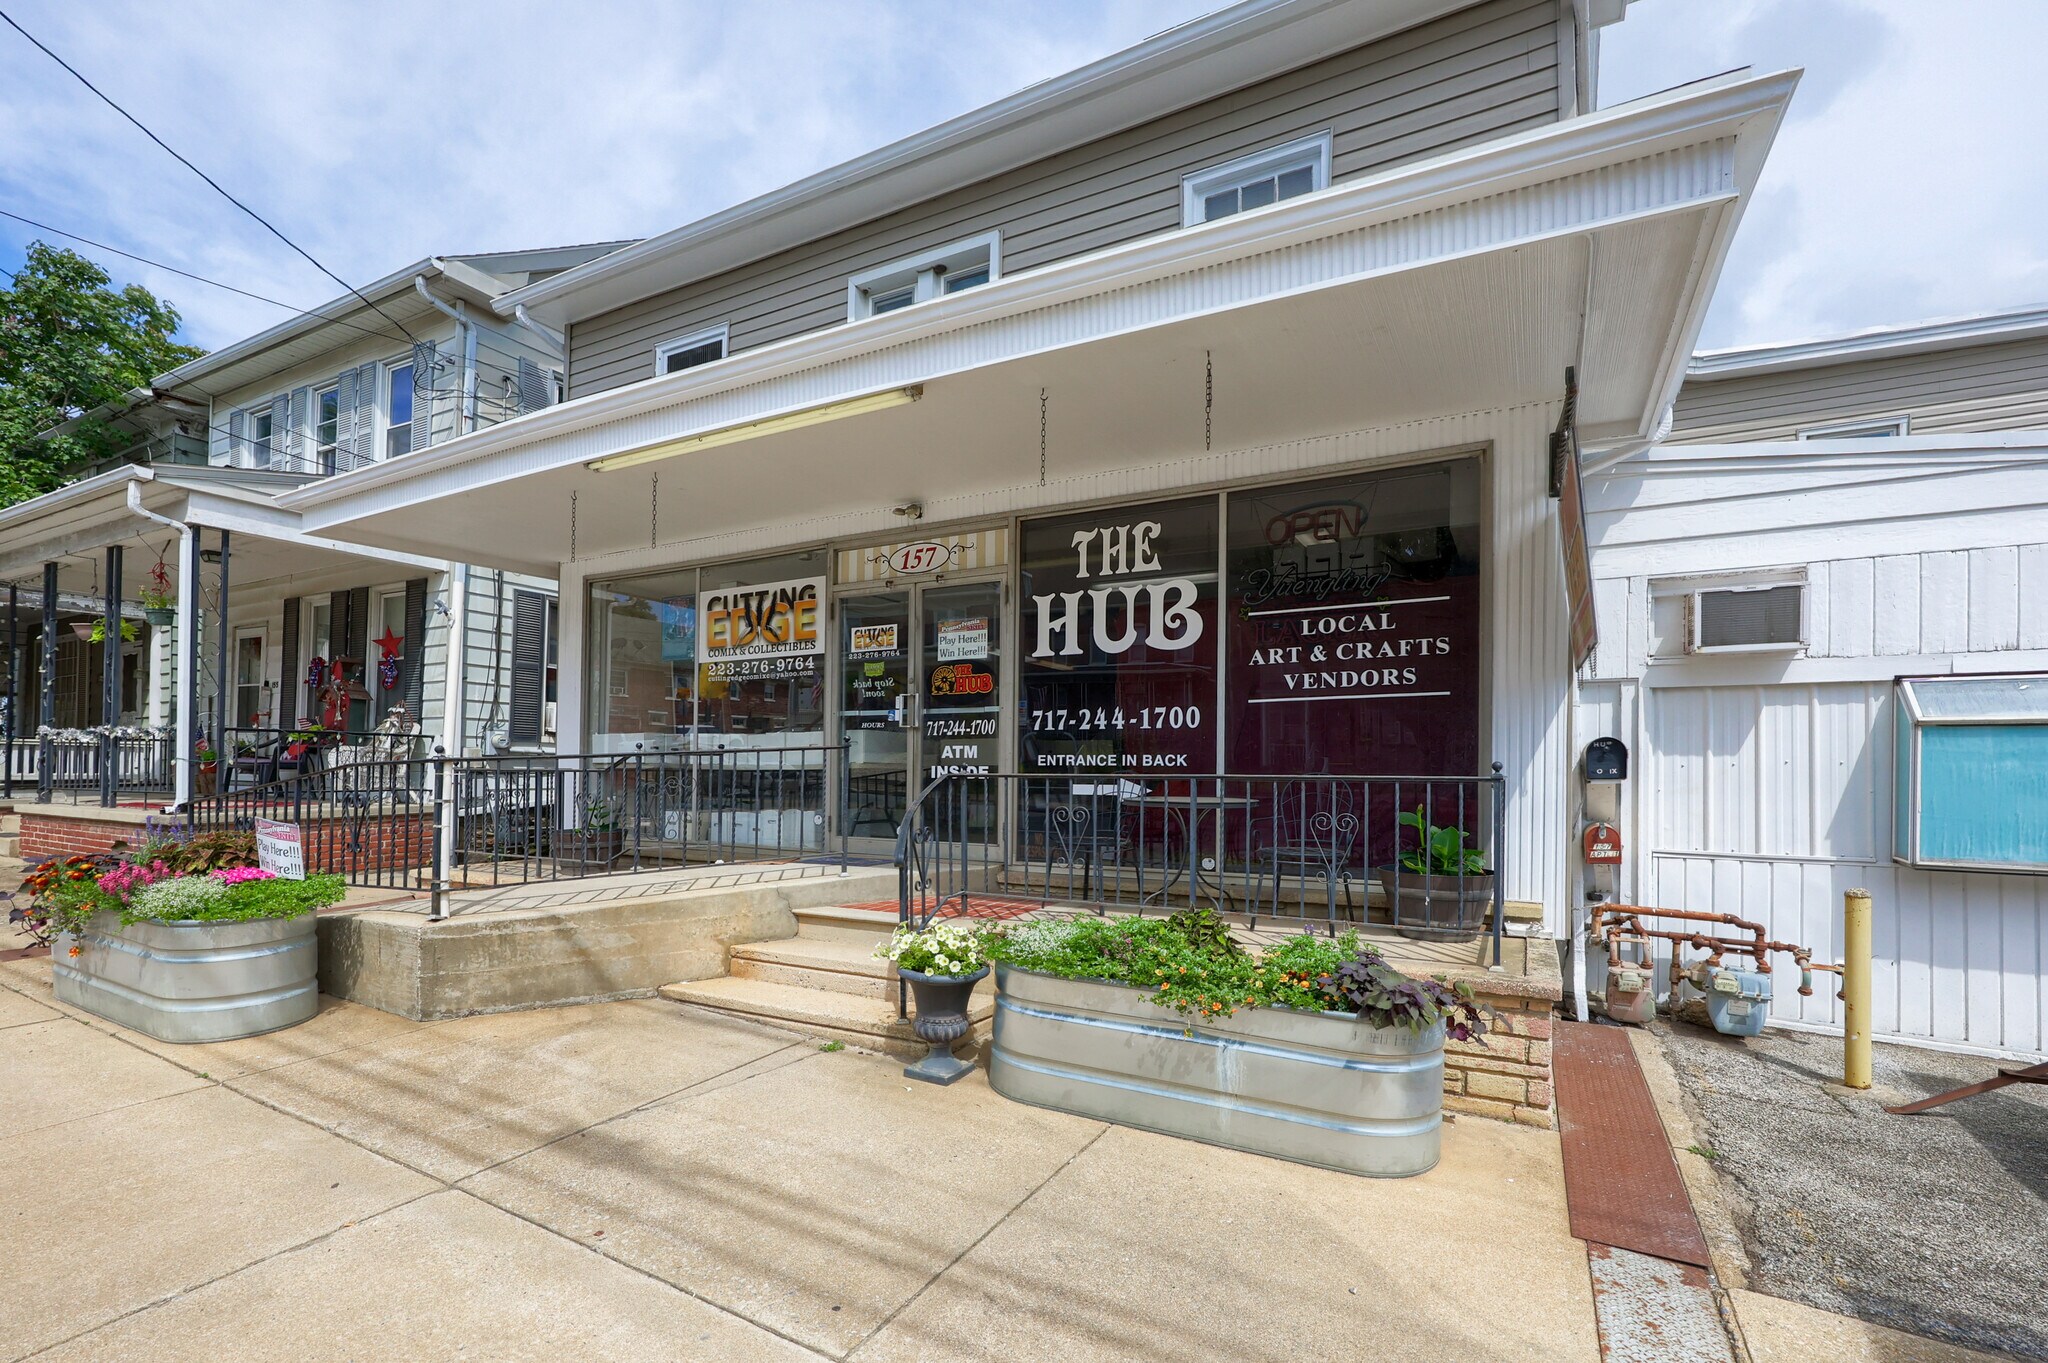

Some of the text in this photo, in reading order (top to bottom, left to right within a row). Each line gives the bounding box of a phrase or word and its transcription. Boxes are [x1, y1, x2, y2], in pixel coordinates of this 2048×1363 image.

[1266, 508, 1361, 545] OPEN
[901, 546, 937, 570] 157
[1071, 520, 1162, 578] THE
[1244, 562, 1392, 605] Yuengling
[707, 584, 816, 616] CUTTING
[707, 599, 817, 648] EDGE
[1032, 579, 1204, 658] HUB
[1301, 613, 1396, 636] LOCAL
[708, 640, 816, 658] COMIX & COLLECTIBLES
[855, 631, 895, 649] EDGE
[939, 633, 986, 646] Play Here!!!
[848, 649, 900, 660] 223-276-9764
[940, 646, 986, 658] Win Here!!!
[1249, 637, 1450, 666] ART & CRAFTS
[708, 656, 815, 675] 223-276-9764
[955, 664, 972, 676] THE
[955, 675, 993, 693] HUB
[1284, 667, 1417, 690] VENDORS
[926, 719, 996, 736] 717-244-1700
[1032, 706, 1201, 731] 717-244-1700
[941, 745, 978, 759] ATM
[1037, 754, 1188, 767] ENTRANCE IN BACK
[931, 765, 990, 780] INSDE
[258, 838, 300, 859] Play Here!!!
[260, 854, 302, 875] Win Here!!!
